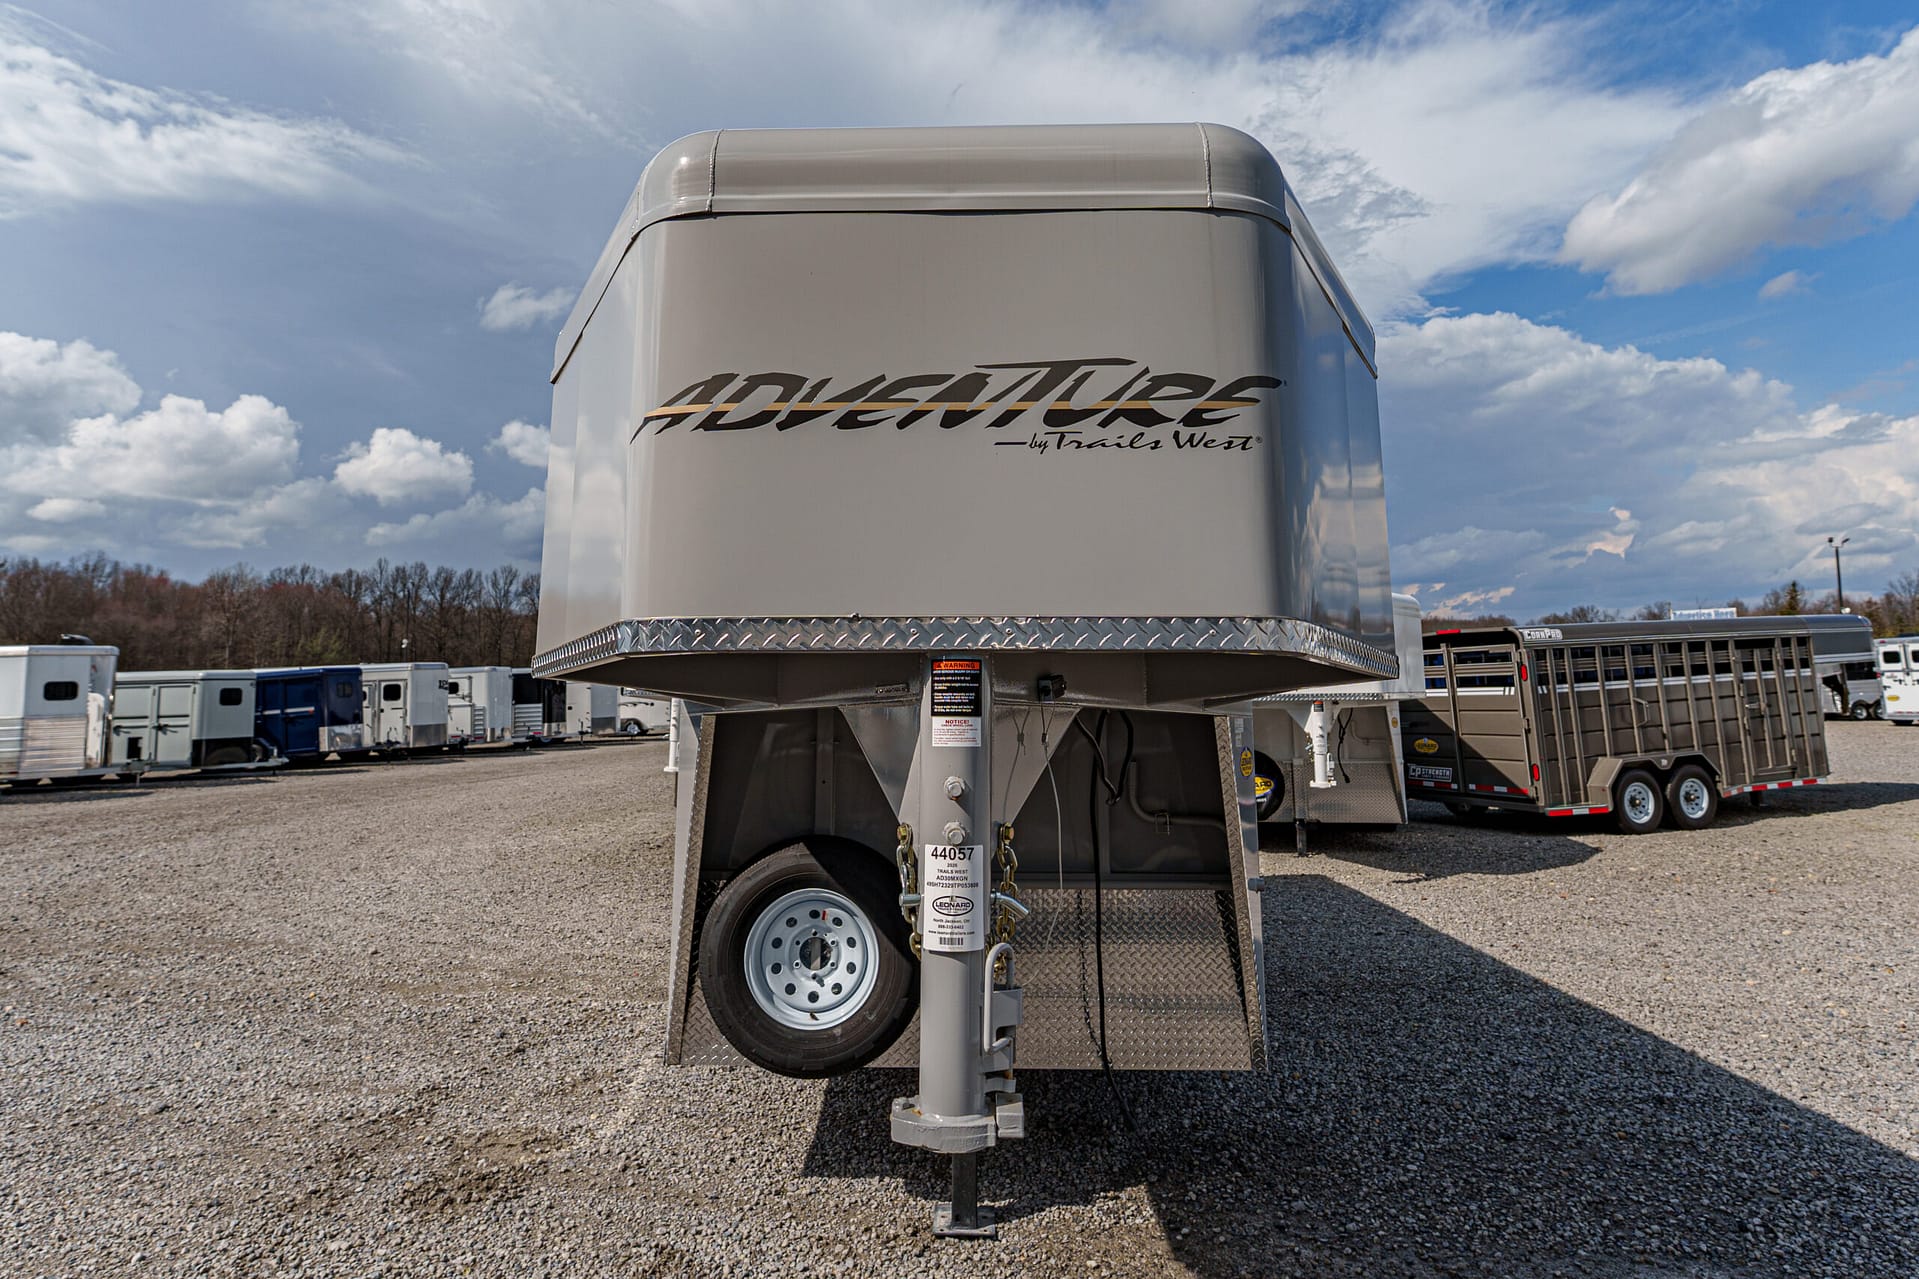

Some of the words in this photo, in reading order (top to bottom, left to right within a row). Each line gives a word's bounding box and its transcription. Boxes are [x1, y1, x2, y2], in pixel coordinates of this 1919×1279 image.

[630, 357, 1282, 445] ADVENTURE
[1044, 430, 1162, 450] Trails
[931, 846, 975, 861] 44057
